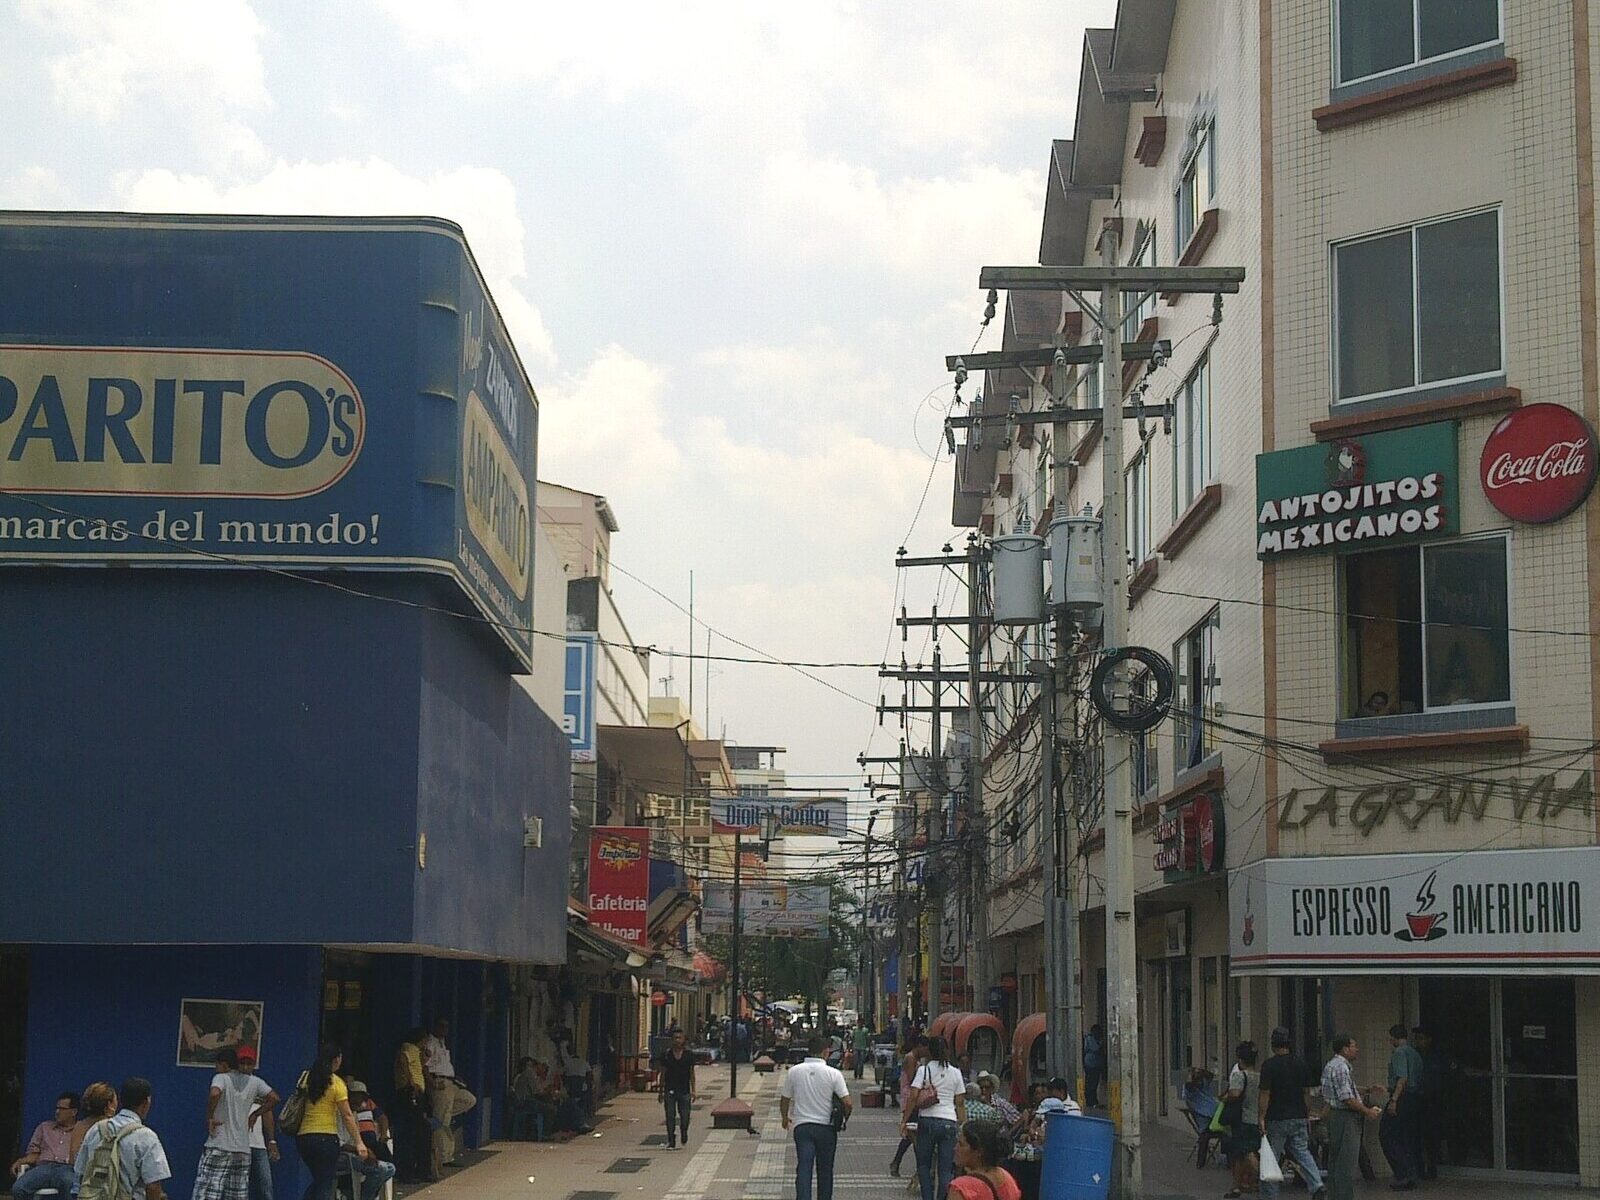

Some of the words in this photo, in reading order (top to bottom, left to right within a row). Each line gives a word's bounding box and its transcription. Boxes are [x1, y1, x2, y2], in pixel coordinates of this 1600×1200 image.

[1486, 437, 1590, 489] Coca-Cola
[1258, 472, 1440, 525] ANTOJITOS
[142, 510, 205, 542] del
[218, 513, 380, 545] mundo!
[1256, 505, 1442, 554] MEXICANOS
[781, 803, 830, 826] Center
[1278, 784, 1338, 829] LA
[1350, 775, 1496, 837] GRAN
[1509, 769, 1593, 820] VIA
[589, 894, 647, 912] Cafeteria
[1292, 886, 1392, 936] ESPRESSO
[1453, 881, 1582, 934] AMERICANO
